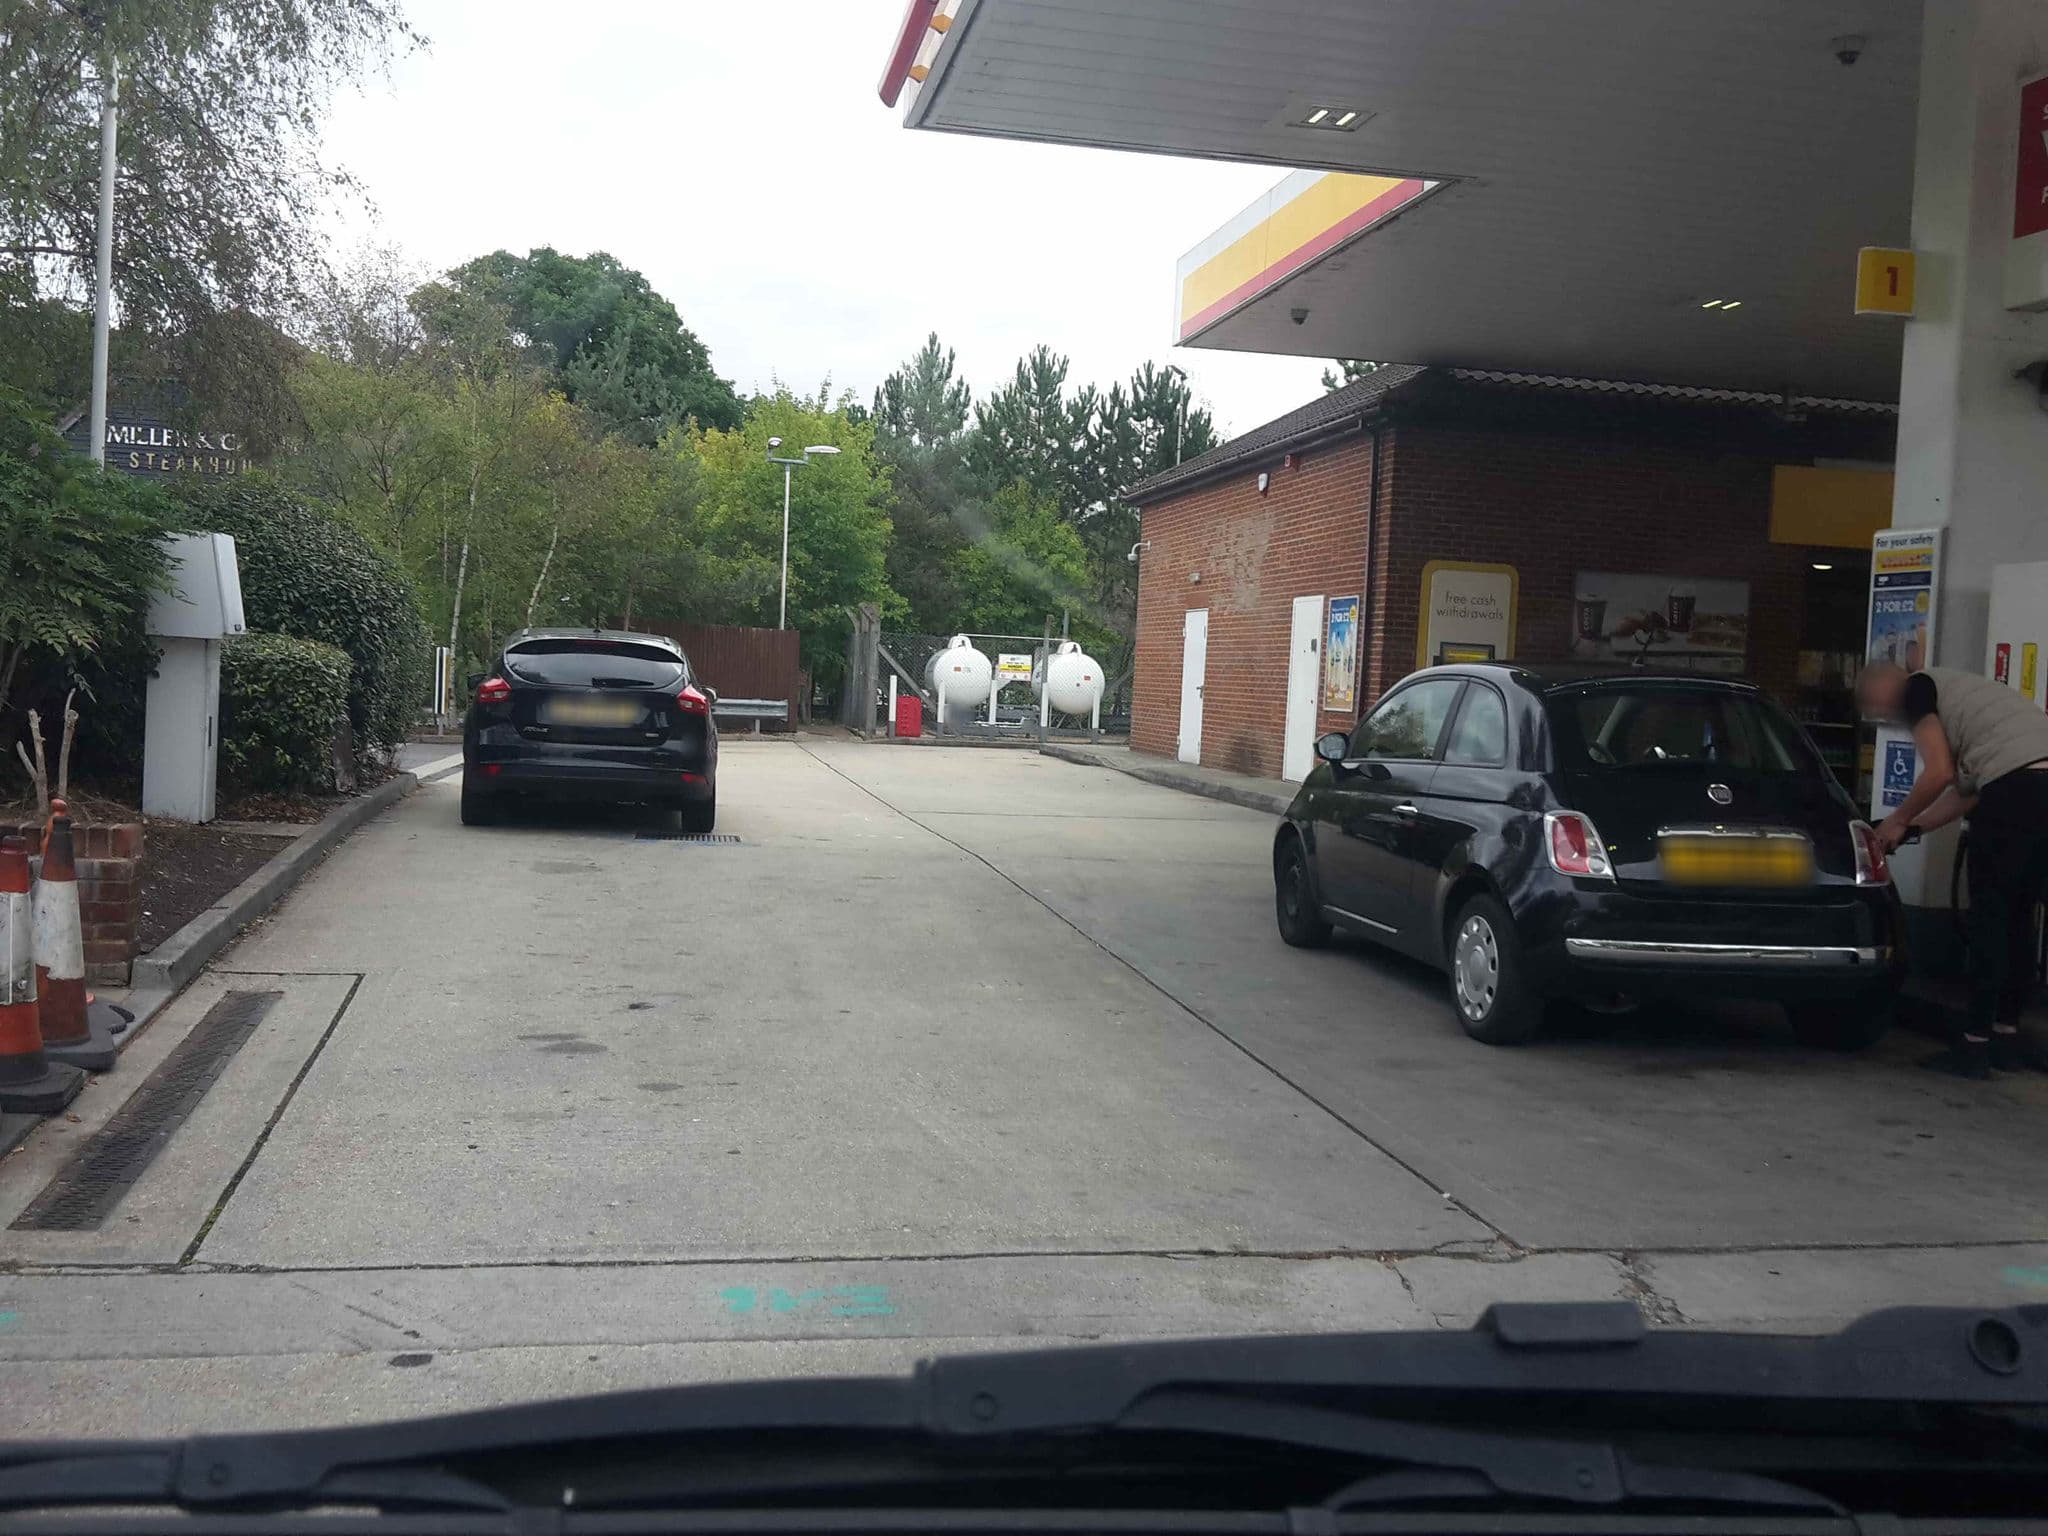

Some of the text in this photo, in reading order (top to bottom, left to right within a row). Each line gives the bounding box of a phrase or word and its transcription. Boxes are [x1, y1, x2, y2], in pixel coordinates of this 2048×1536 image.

[1886, 266, 1899, 297] 1
[1876, 535, 1934, 549] For your safety
[1445, 591, 1496, 606] free cash
[1437, 606, 1504, 620] withdrawals
[1875, 600, 1882, 613] 2
[1883, 600, 1901, 613] FOR
